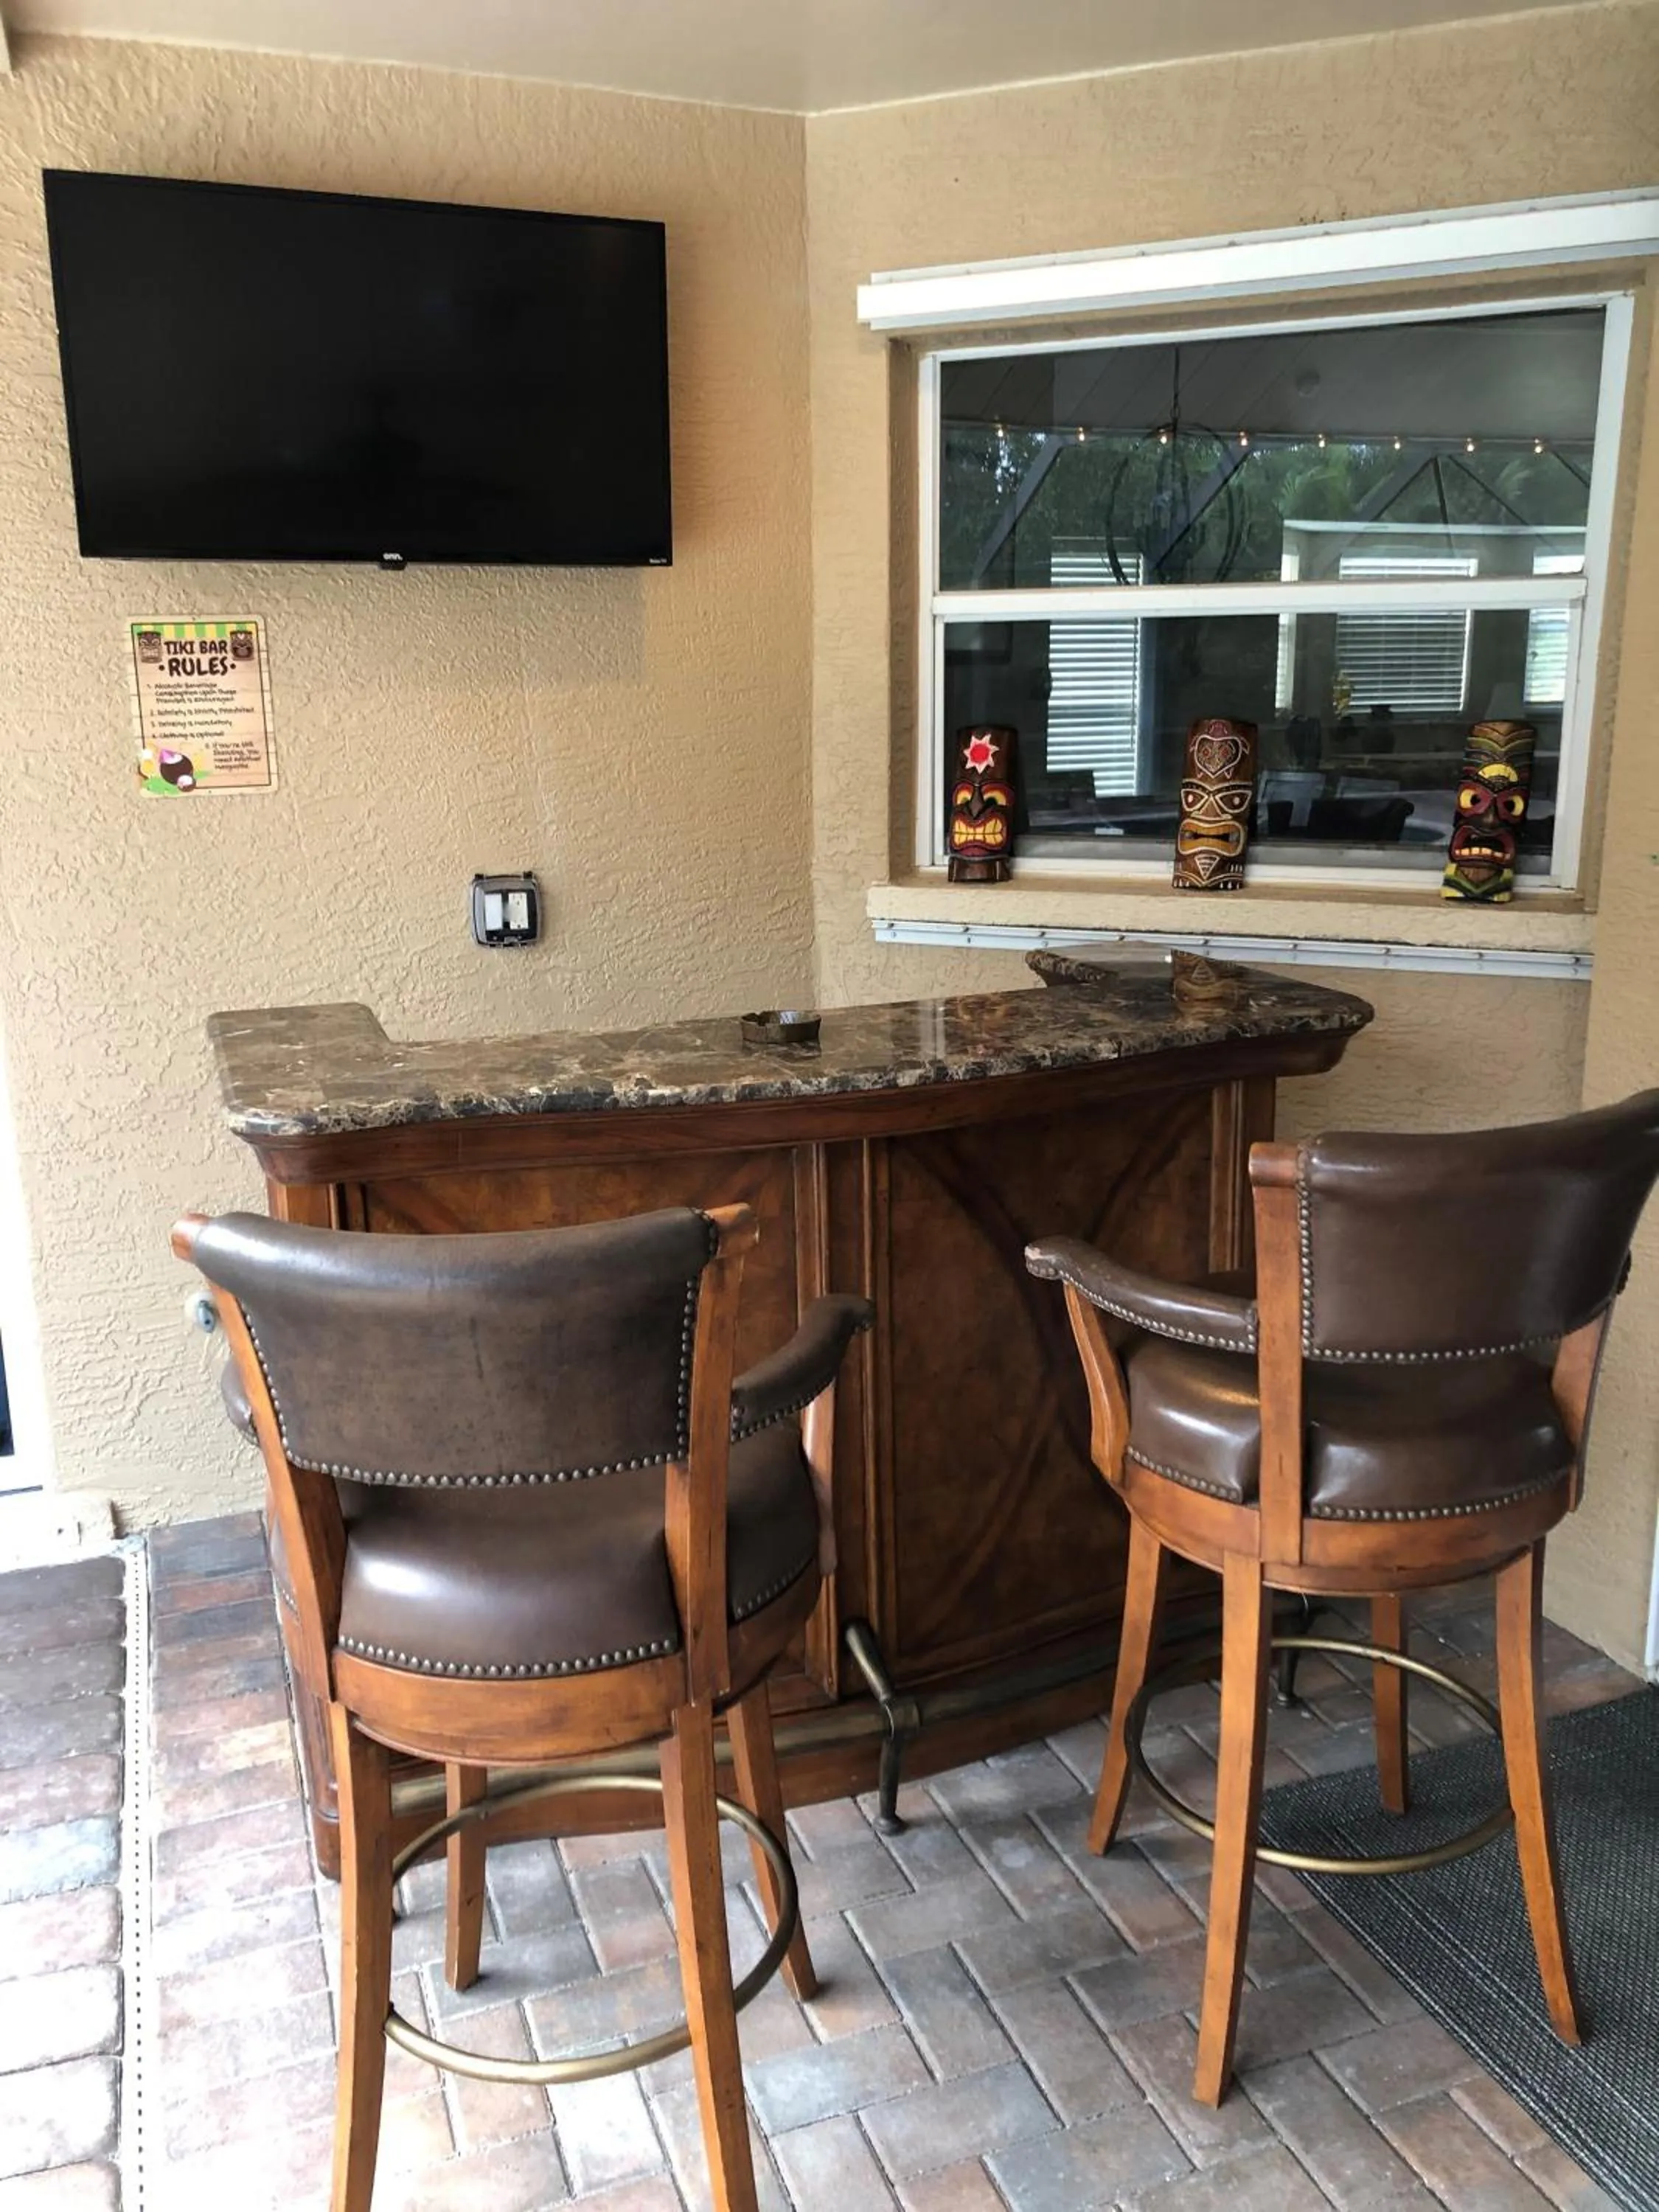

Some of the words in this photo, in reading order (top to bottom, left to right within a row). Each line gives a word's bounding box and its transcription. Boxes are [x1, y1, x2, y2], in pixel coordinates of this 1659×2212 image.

[164, 640, 195, 655] TIKI
[200, 639, 228, 655] BAR
[168, 656, 228, 677] RULES
